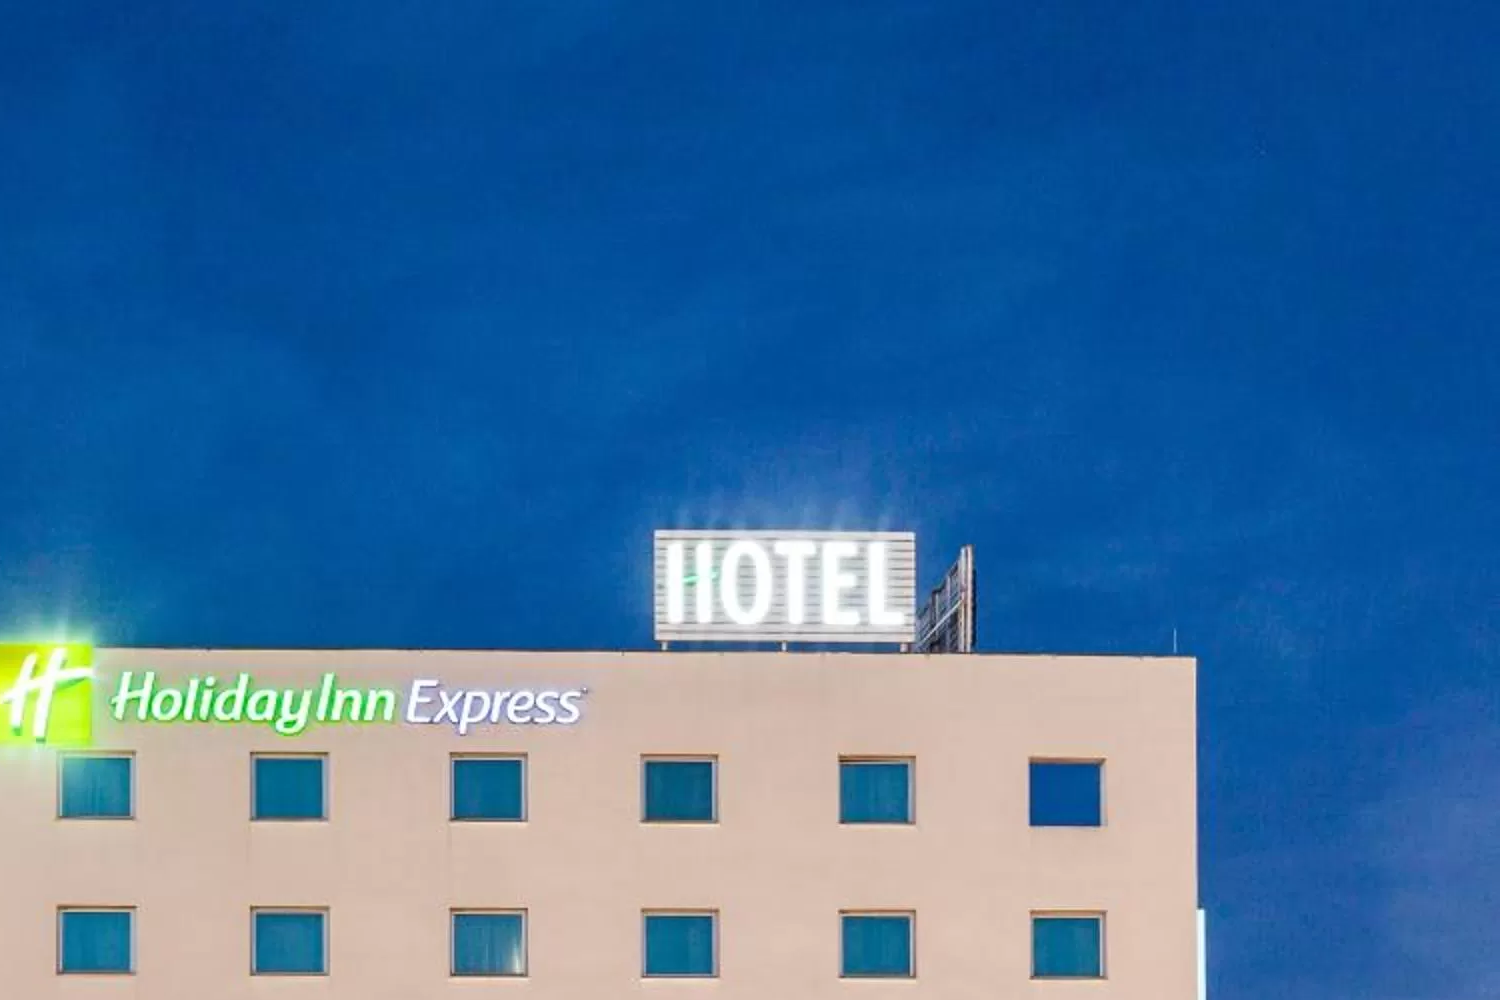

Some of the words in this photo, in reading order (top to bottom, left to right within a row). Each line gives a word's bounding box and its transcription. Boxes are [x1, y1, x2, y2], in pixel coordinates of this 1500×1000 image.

[666, 539, 906, 626] HOTEL
[110, 670, 312, 735] Holiday
[315, 671, 396, 722] Inn
[406, 678, 583, 736] Express
